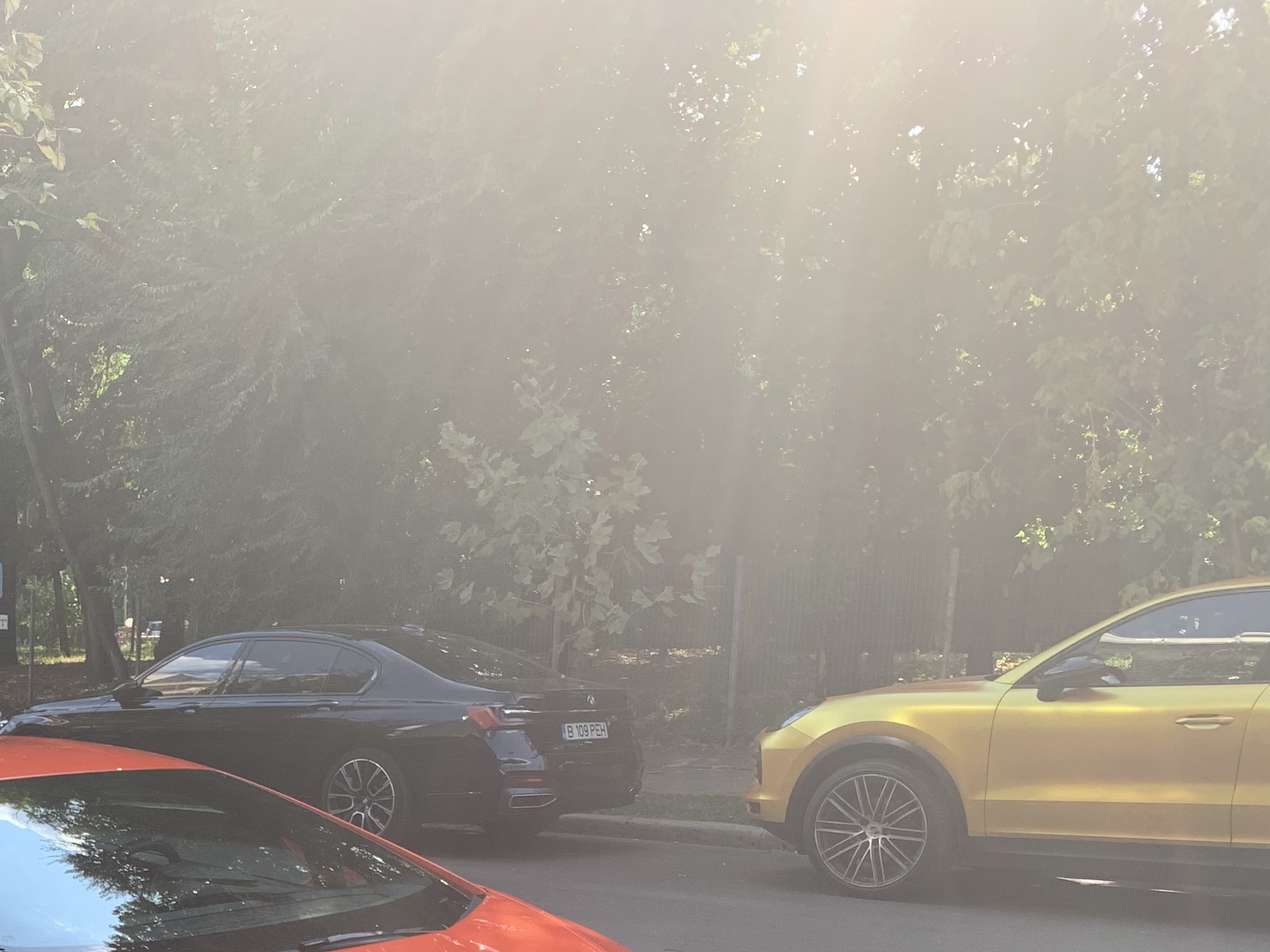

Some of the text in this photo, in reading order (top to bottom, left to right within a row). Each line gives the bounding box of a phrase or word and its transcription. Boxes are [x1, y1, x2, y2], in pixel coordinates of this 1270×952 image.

[567, 723, 607, 738] B 109 PEH
